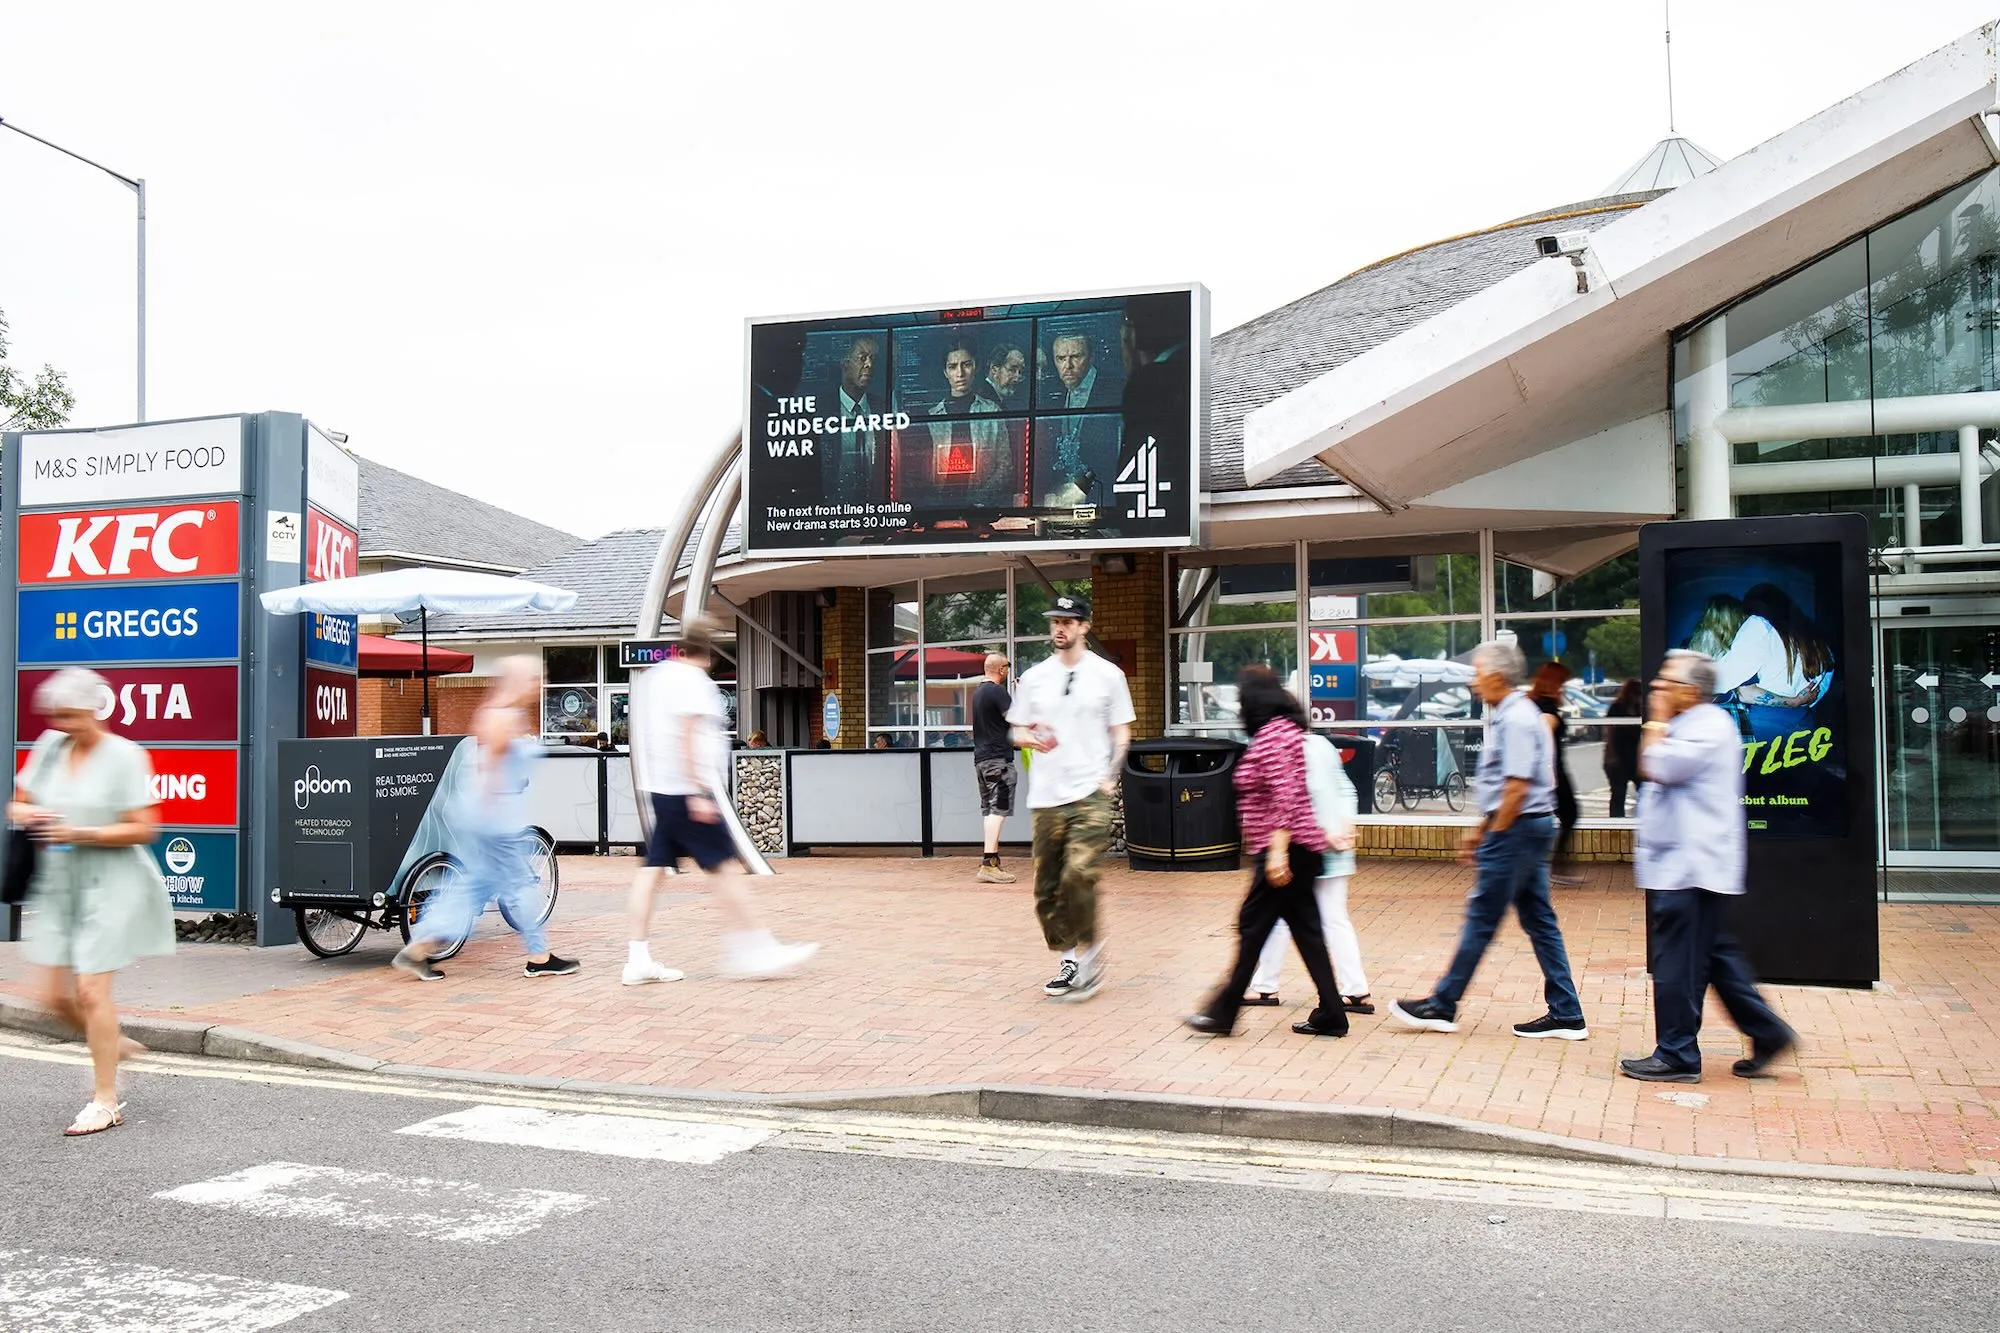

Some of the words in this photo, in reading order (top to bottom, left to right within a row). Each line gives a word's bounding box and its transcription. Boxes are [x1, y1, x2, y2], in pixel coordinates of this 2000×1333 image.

[767, 412, 910, 437] UNDECLARED
[767, 439, 814, 457] WAR
[35, 457, 77, 480] M&S
[85, 451, 158, 476] SIMPLY
[165, 446, 226, 471] FOOD
[1112, 435, 1171, 519] 4
[766, 507, 787, 518] The
[788, 506, 812, 517] next
[815, 504, 841, 516] front
[843, 503, 863, 515] line
[865, 503, 875, 514] is
[877, 501, 912, 513] online
[766, 520, 791, 531] New
[792, 519, 827, 531] drama
[828, 518, 861, 530] starts
[862, 517, 877, 528] 30
[879, 516, 907, 528] June
[272, 531, 296, 540] CCTV
[313, 519, 352, 581] KFC
[83, 607, 199, 639] GREGGS
[322, 614, 351, 646] GREGGS
[95, 683, 192, 726] OSTA
[316, 684, 348, 725] COSTA
[145, 773, 206, 800] KING
[375, 776, 396, 786] REAL
[396, 772, 435, 784] TOBACCO.
[375, 788, 389, 798] NO
[390, 785, 419, 797] SMOKE.
[1738, 795, 1765, 805] ebut
[1769, 795, 1808, 805] album
[295, 819, 320, 827] HEATED
[320, 819, 352, 827] TOBACCO
[301, 828, 345, 836] TECHNOLOGY
[161, 875, 204, 893] HOW
[177, 894, 204, 904] kitchen
